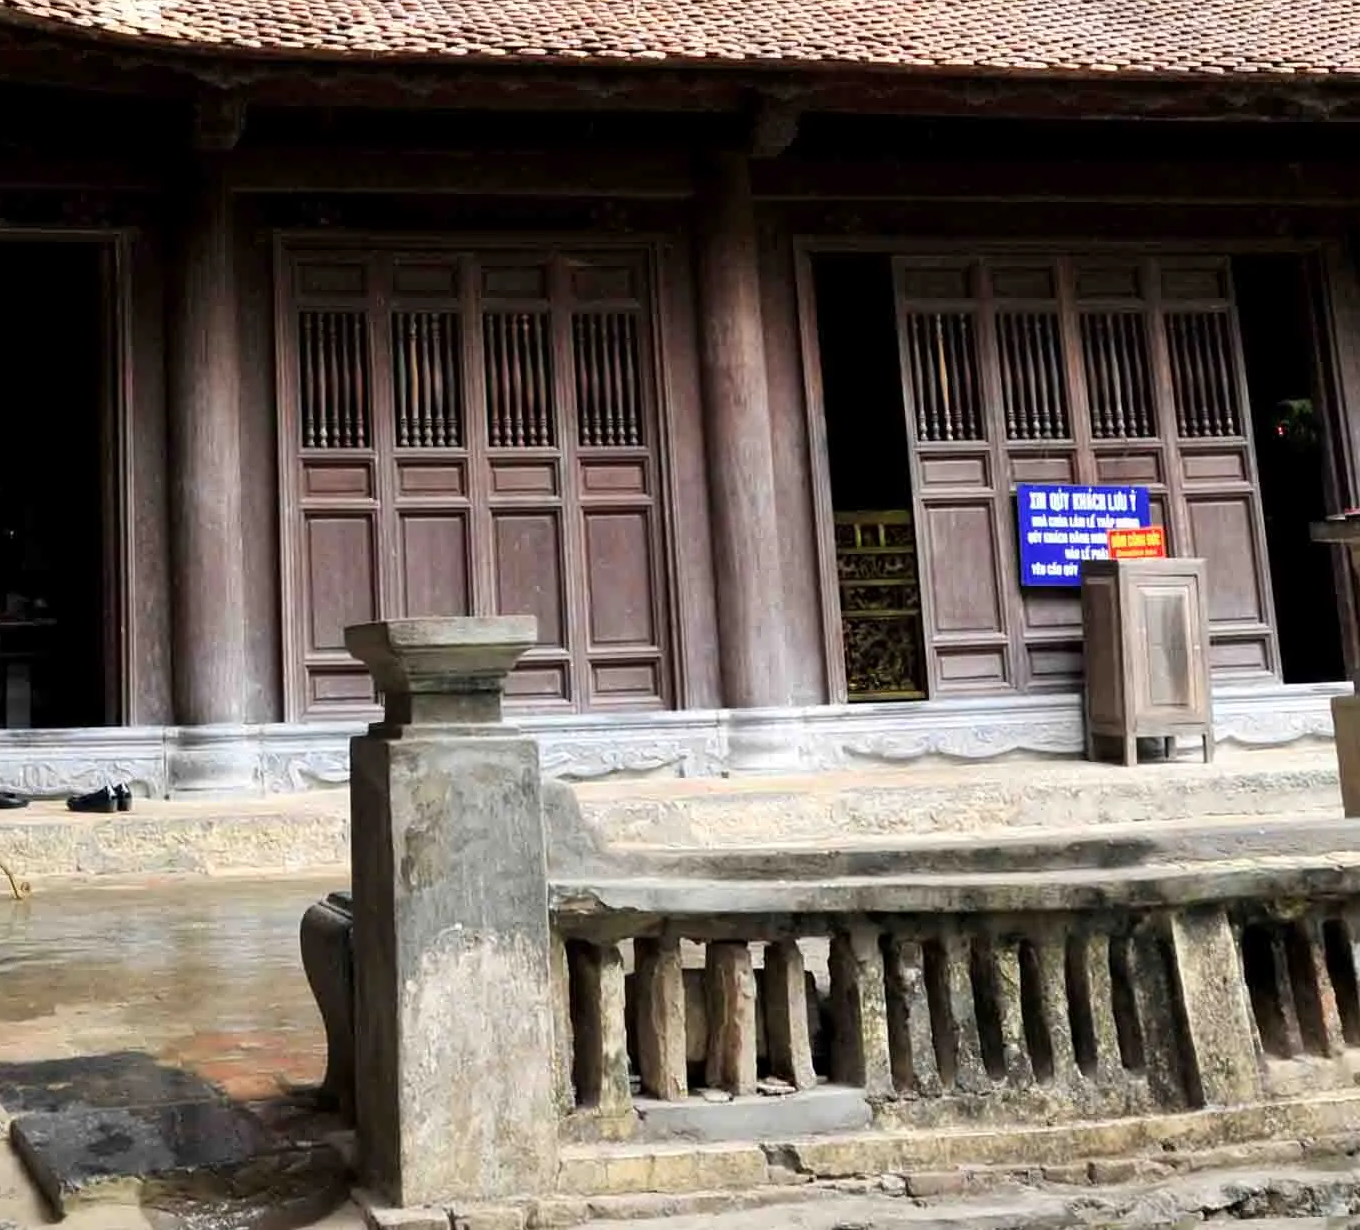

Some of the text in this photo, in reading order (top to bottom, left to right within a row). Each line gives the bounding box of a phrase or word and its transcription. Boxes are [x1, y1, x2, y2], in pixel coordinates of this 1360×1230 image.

[1029, 491, 1047, 510] XIN
[1049, 488, 1069, 511] QUÝ
[1072, 487, 1106, 511] KHÁCH
